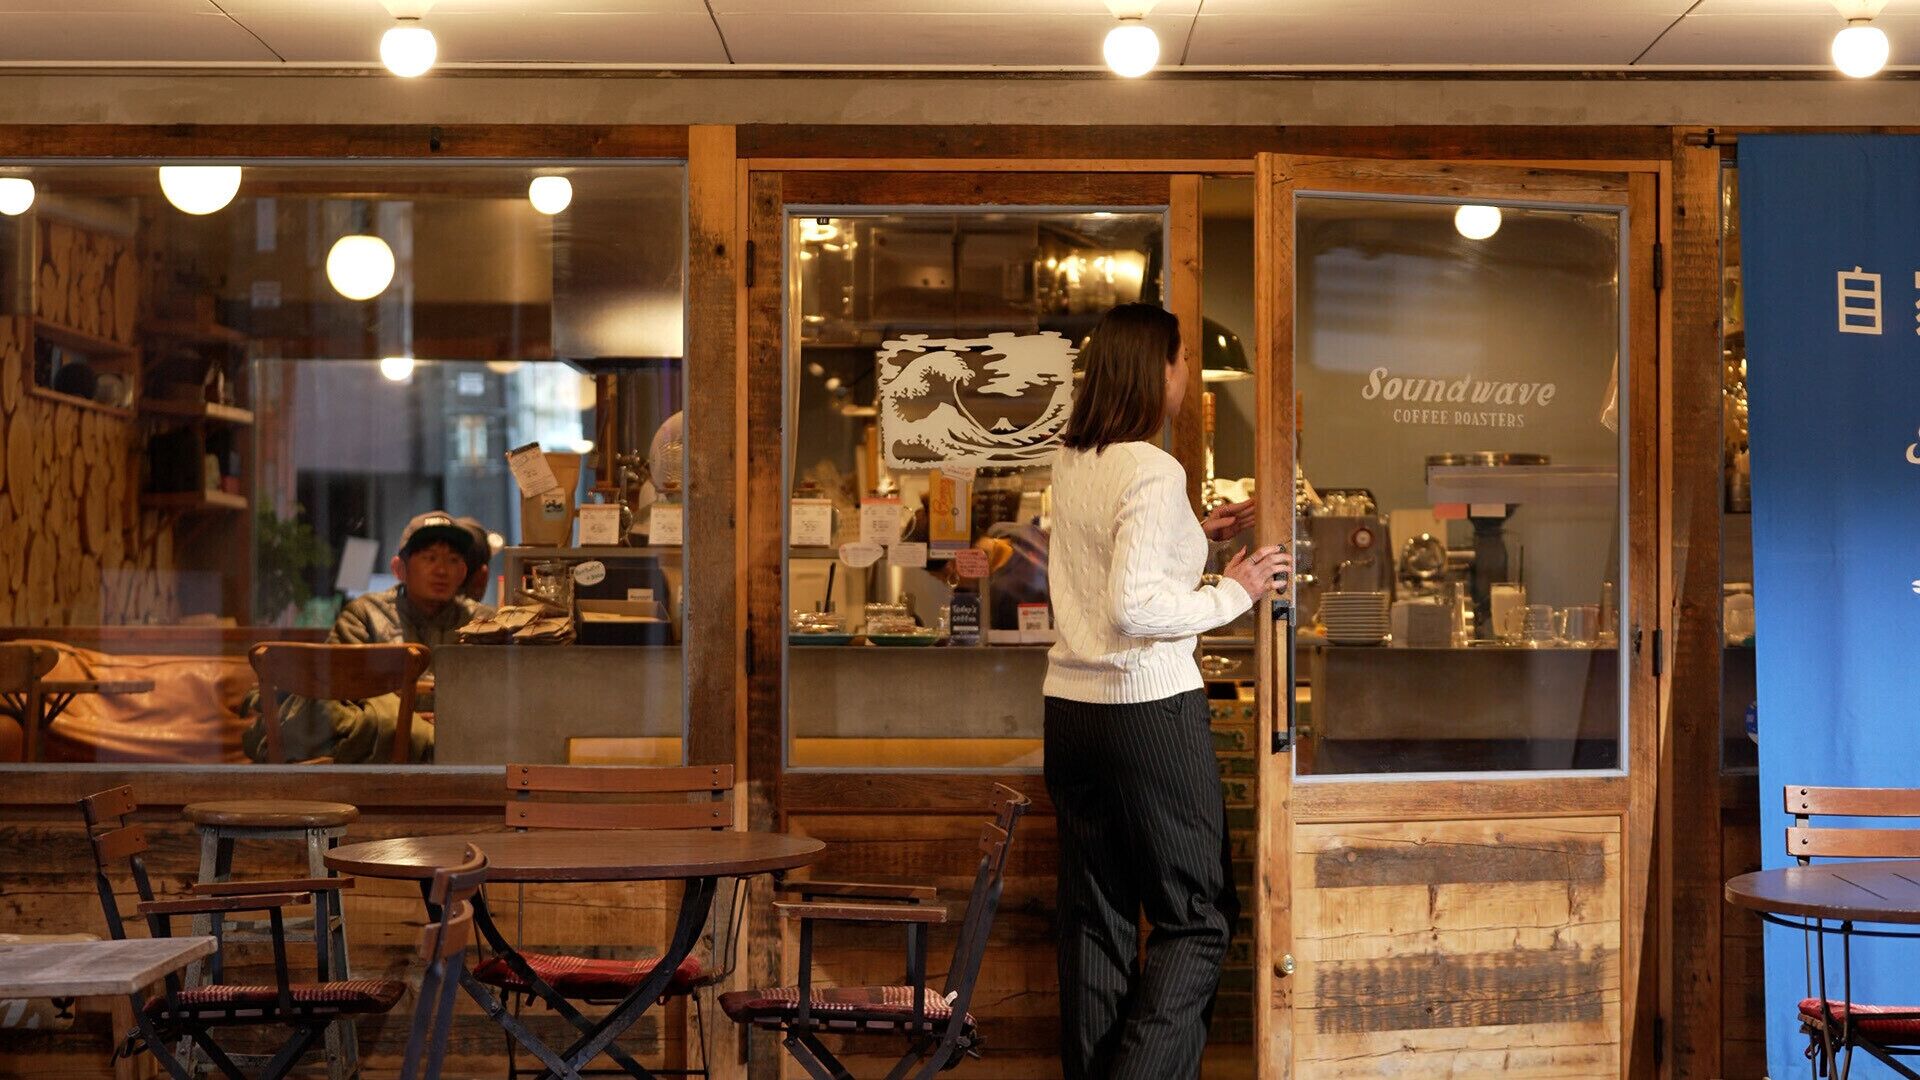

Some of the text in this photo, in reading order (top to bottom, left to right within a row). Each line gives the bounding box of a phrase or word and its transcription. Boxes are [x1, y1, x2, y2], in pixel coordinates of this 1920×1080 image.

[1361, 367, 1556, 407] Soundwave
[1393, 408, 1525, 428] COFFEE ROASTERS
